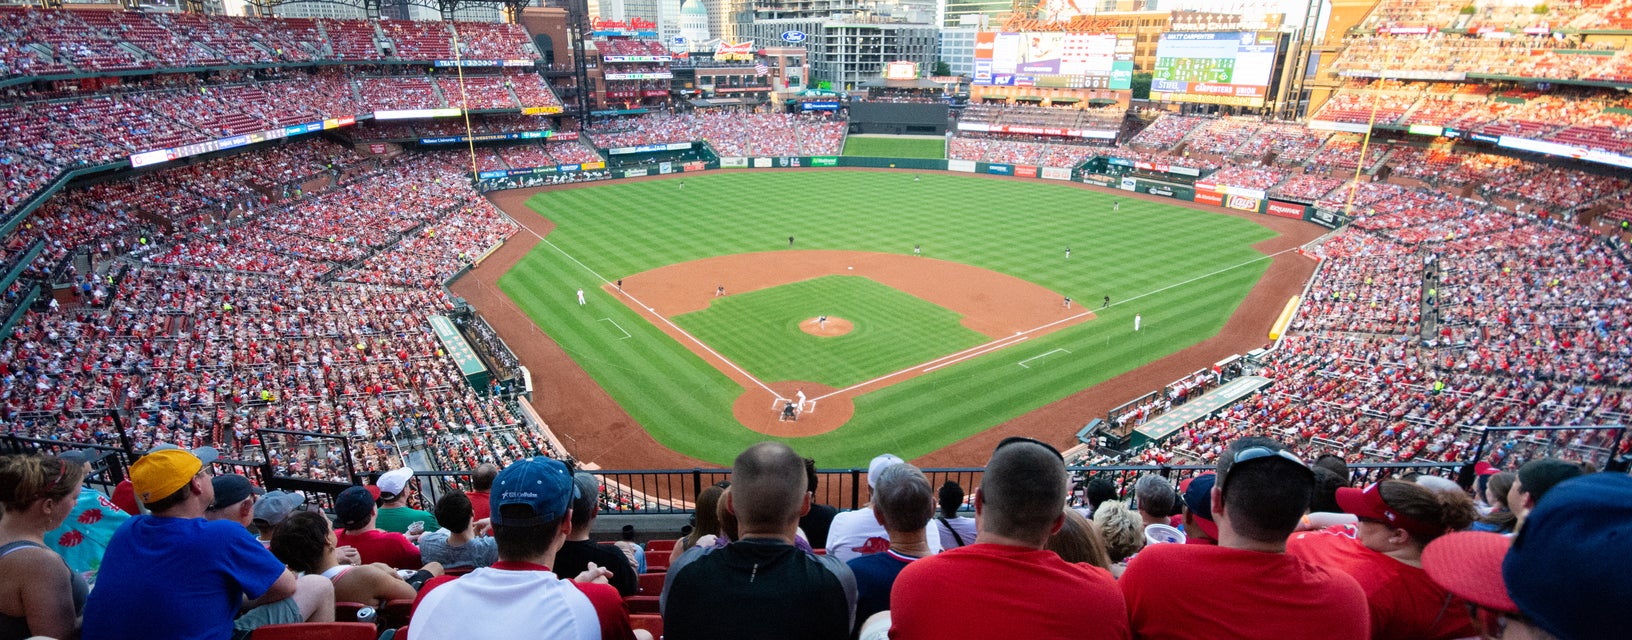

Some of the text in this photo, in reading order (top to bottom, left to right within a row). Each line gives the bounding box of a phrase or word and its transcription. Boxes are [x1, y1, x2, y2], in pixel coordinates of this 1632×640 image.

[592, 16, 657, 30] Cardinals Nation
[996, 12, 1119, 33] Budweiser
[1173, 22, 1268, 32] WORLD CHAMPIONS
[1195, 85, 1232, 94] CARPENTERS
